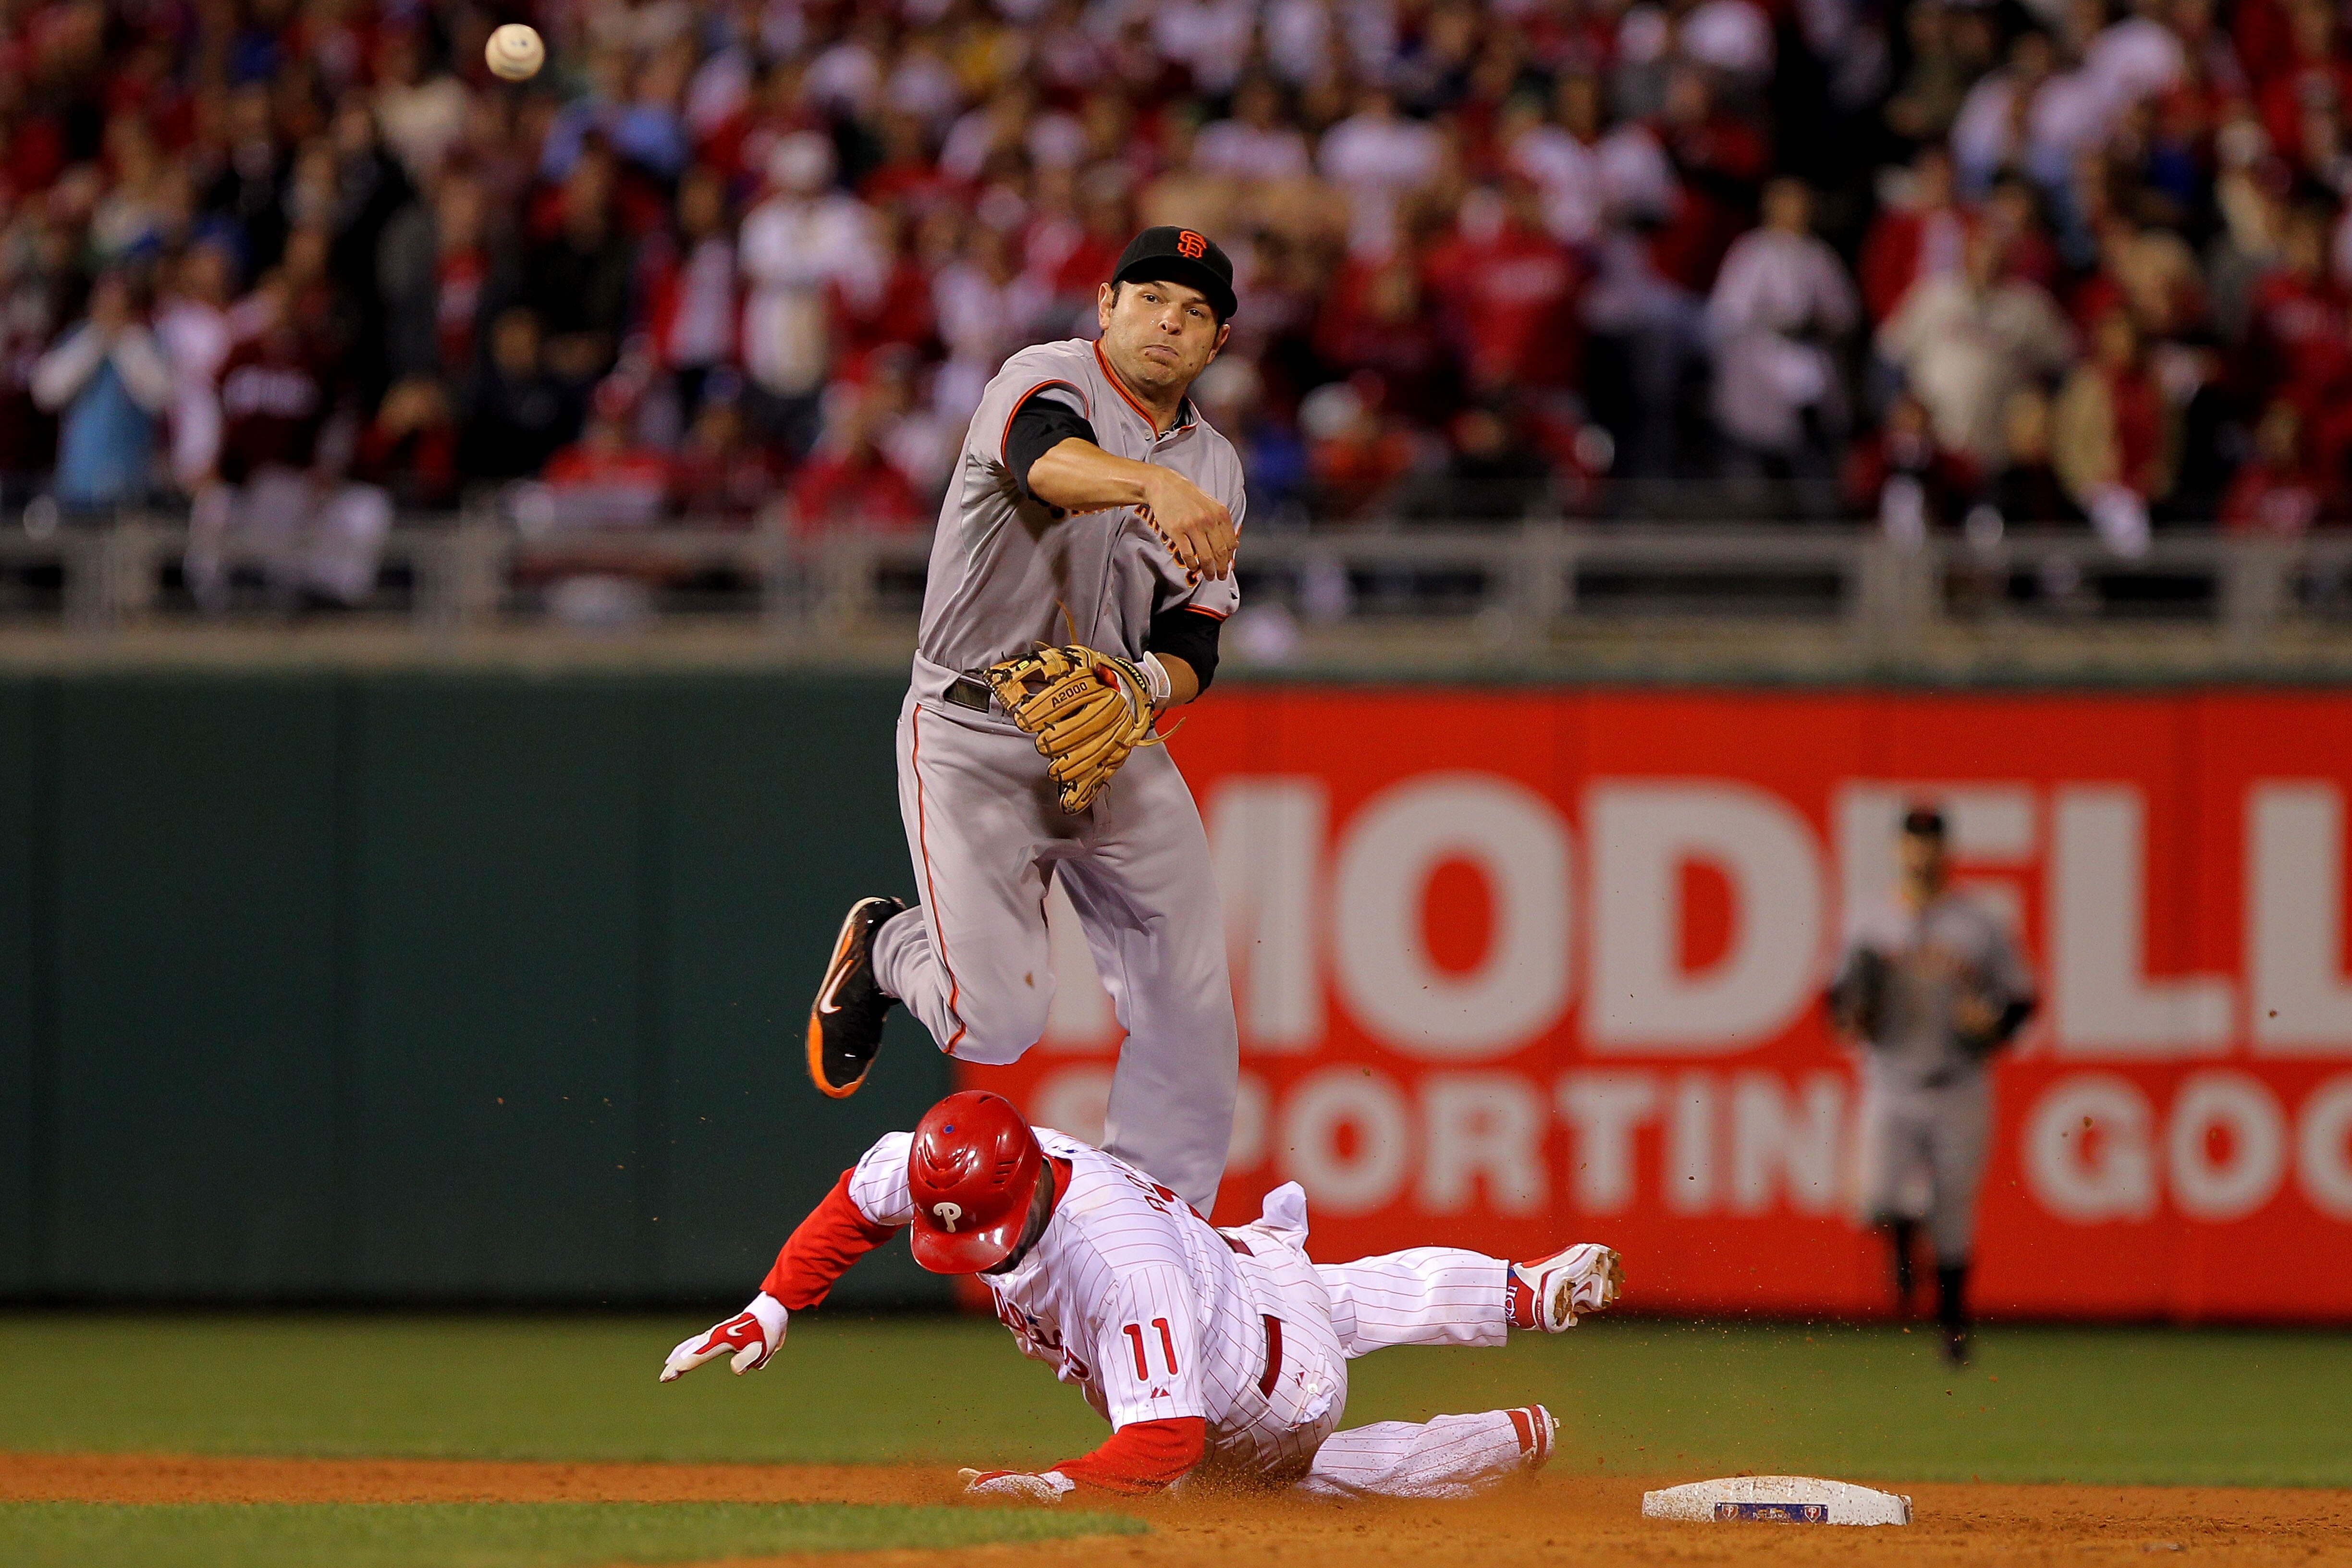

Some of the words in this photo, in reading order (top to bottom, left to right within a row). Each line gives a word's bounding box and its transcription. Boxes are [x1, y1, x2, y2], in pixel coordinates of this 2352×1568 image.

[1051, 682, 1088, 708] A2000
[933, 1202, 962, 1233] P
[1123, 1317, 1180, 1382] 11
